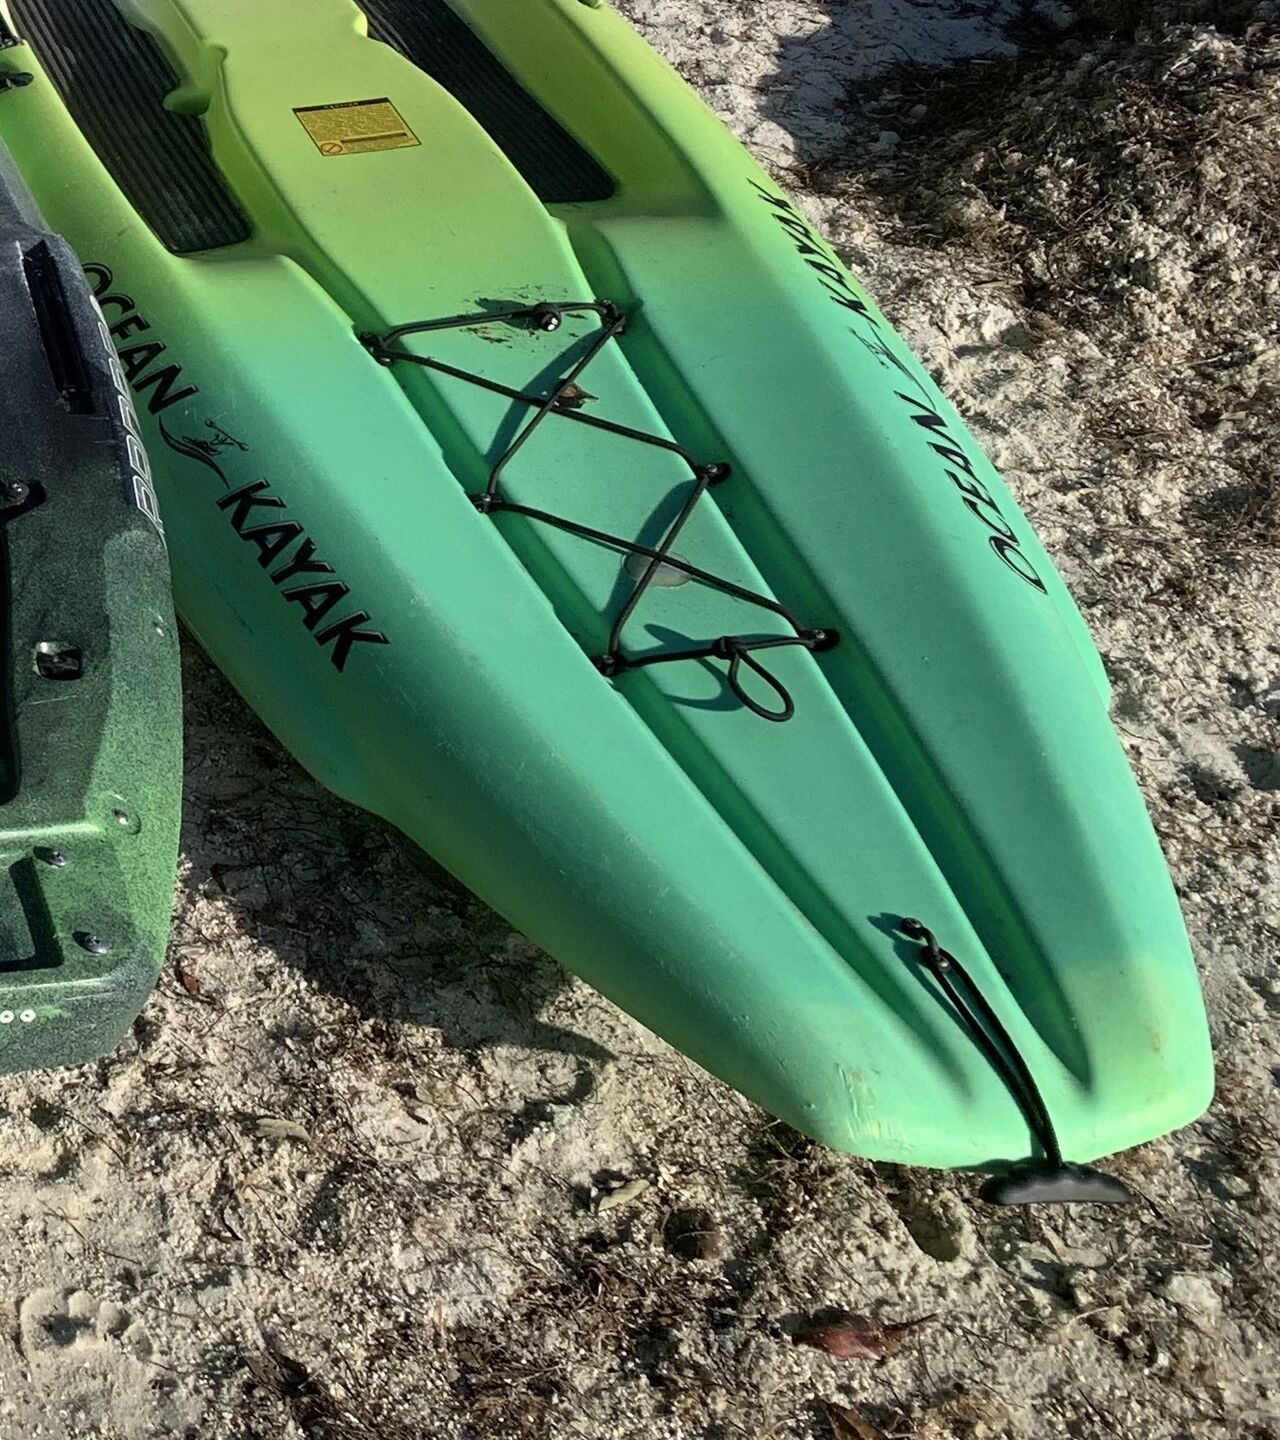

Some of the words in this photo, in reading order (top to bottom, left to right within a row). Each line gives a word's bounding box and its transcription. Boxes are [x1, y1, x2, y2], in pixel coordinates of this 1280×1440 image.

[746, 178, 873, 317] KAYAK
[217, 478, 391, 673] KAYAK
[894, 391, 1047, 596] OCEAN
